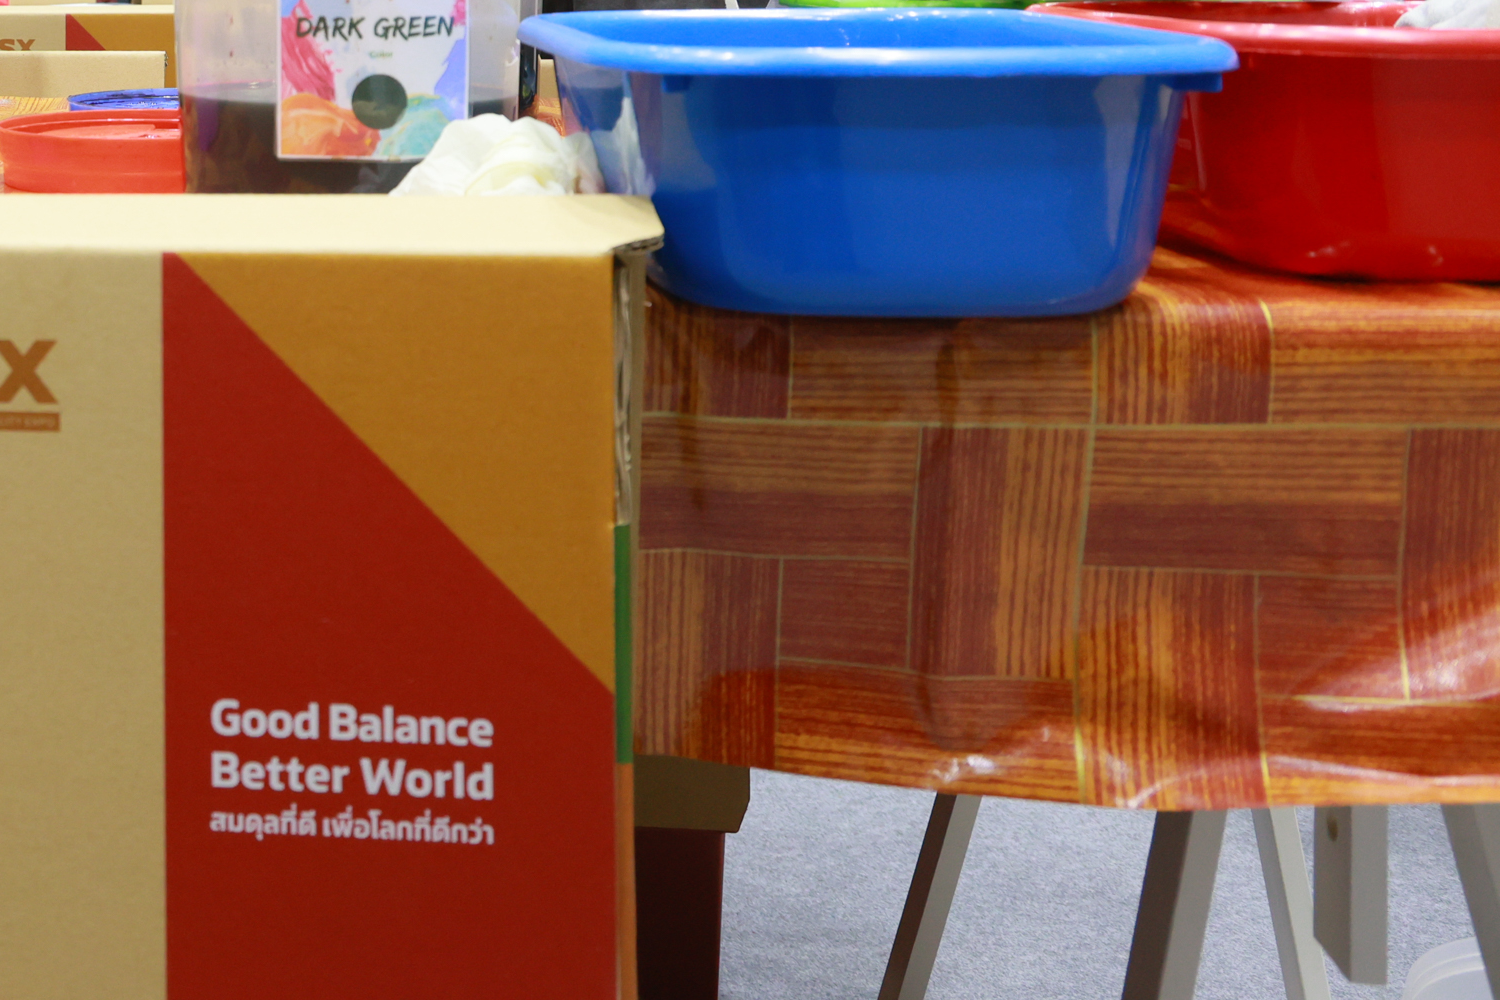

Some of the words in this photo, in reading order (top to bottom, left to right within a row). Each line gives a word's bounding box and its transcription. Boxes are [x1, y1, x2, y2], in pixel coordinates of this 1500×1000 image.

[296, 16, 365, 41] DARK
[374, 16, 455, 41] GREEN
[210, 698, 320, 740] Good
[329, 702, 494, 748] Balance
[211, 751, 350, 793] Better
[359, 757, 494, 801] World
[209, 802, 317, 841] สมดุลที่ดี
[322, 804, 495, 845] เพื่อโลกที่ดีกว่า
